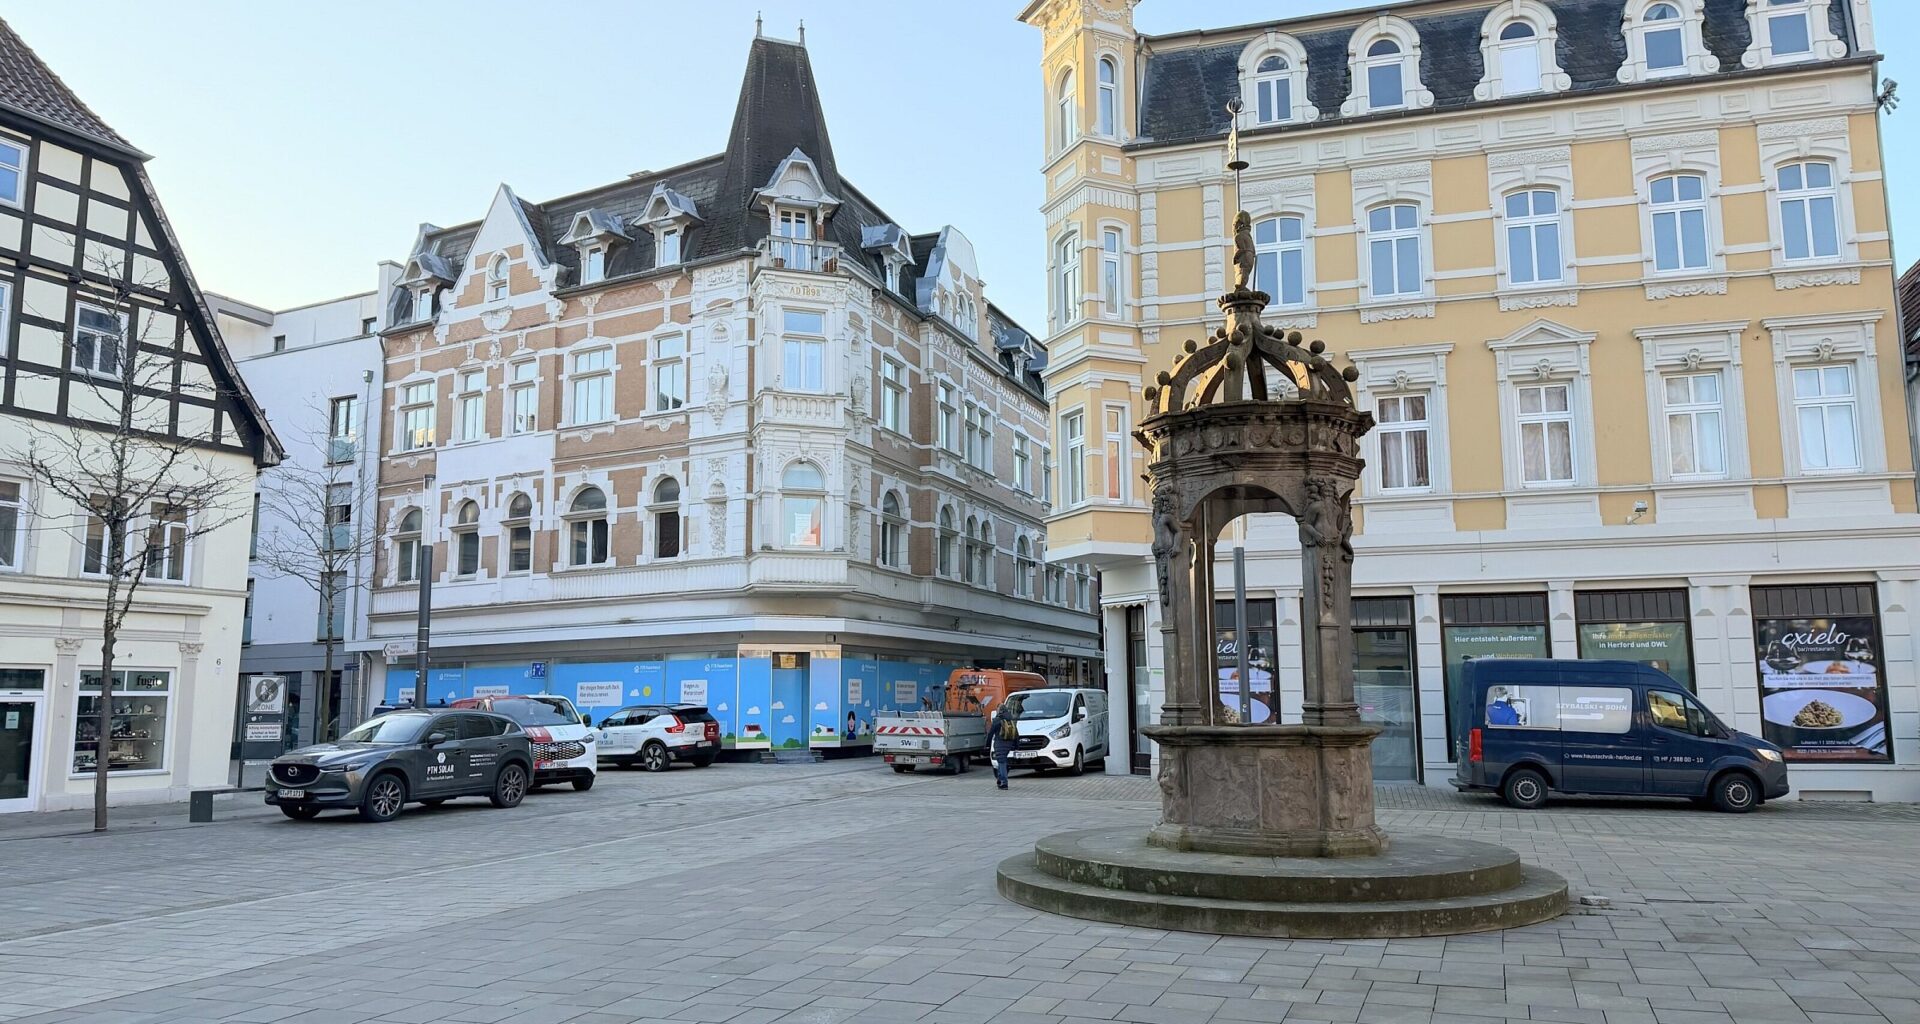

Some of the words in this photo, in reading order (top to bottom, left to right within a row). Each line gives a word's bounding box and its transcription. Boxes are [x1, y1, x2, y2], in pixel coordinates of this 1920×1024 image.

[802, 287, 821, 297] 1898
[1471, 635, 1499, 643] entsteht
[1782, 623, 1850, 650] cxielo
[216, 658, 222, 666] 6
[83, 674, 121, 686] Temus
[136, 674, 159, 689] fugit
[427, 766, 438, 774] PTM
[438, 764, 454, 774] SOLAR
